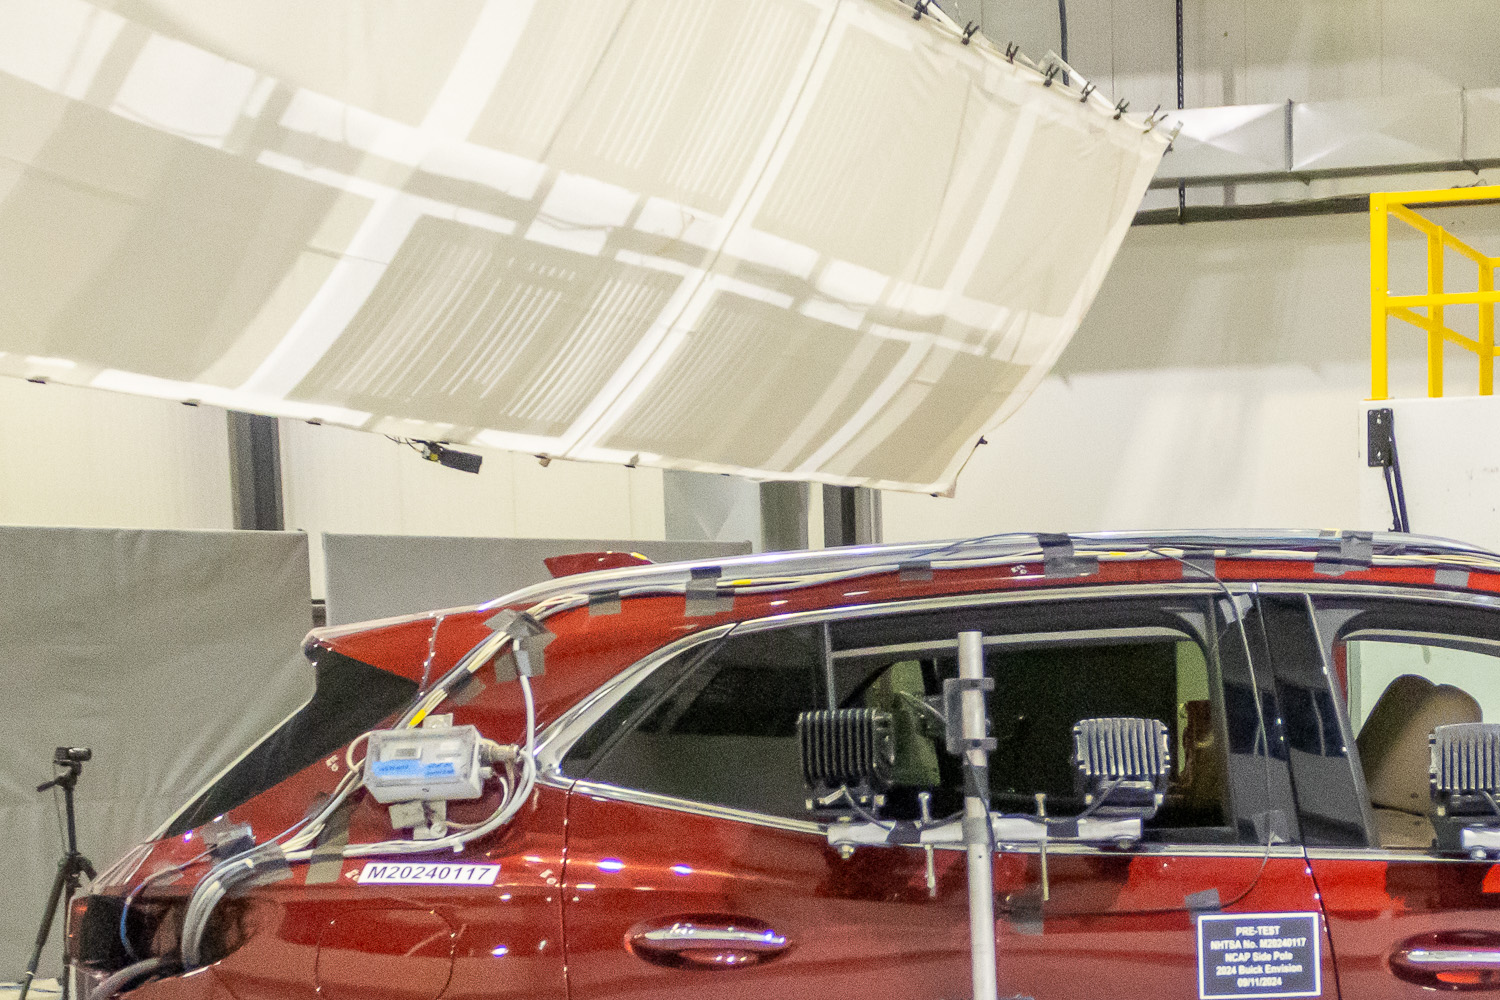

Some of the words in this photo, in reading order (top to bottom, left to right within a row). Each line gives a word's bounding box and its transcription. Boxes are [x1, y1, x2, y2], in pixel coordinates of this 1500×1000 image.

[367, 867, 492, 880] M20240117
[1236, 926, 1280, 936] PRE-TEST
[1211, 940, 1242, 950] NHTSA
[1243, 940, 1258, 949] No.
[1260, 938, 1306, 948] M20240117
[1225, 952, 1251, 962] NCAP
[1253, 952, 1272, 961] Side
[1273, 951, 1293, 960] Pole
[1216, 966, 1237, 976] 2024
[1238, 965, 1263, 975] Buick
[1265, 964, 1303, 974] Envision
[1237, 977, 1282, 987] 09/11/2024
